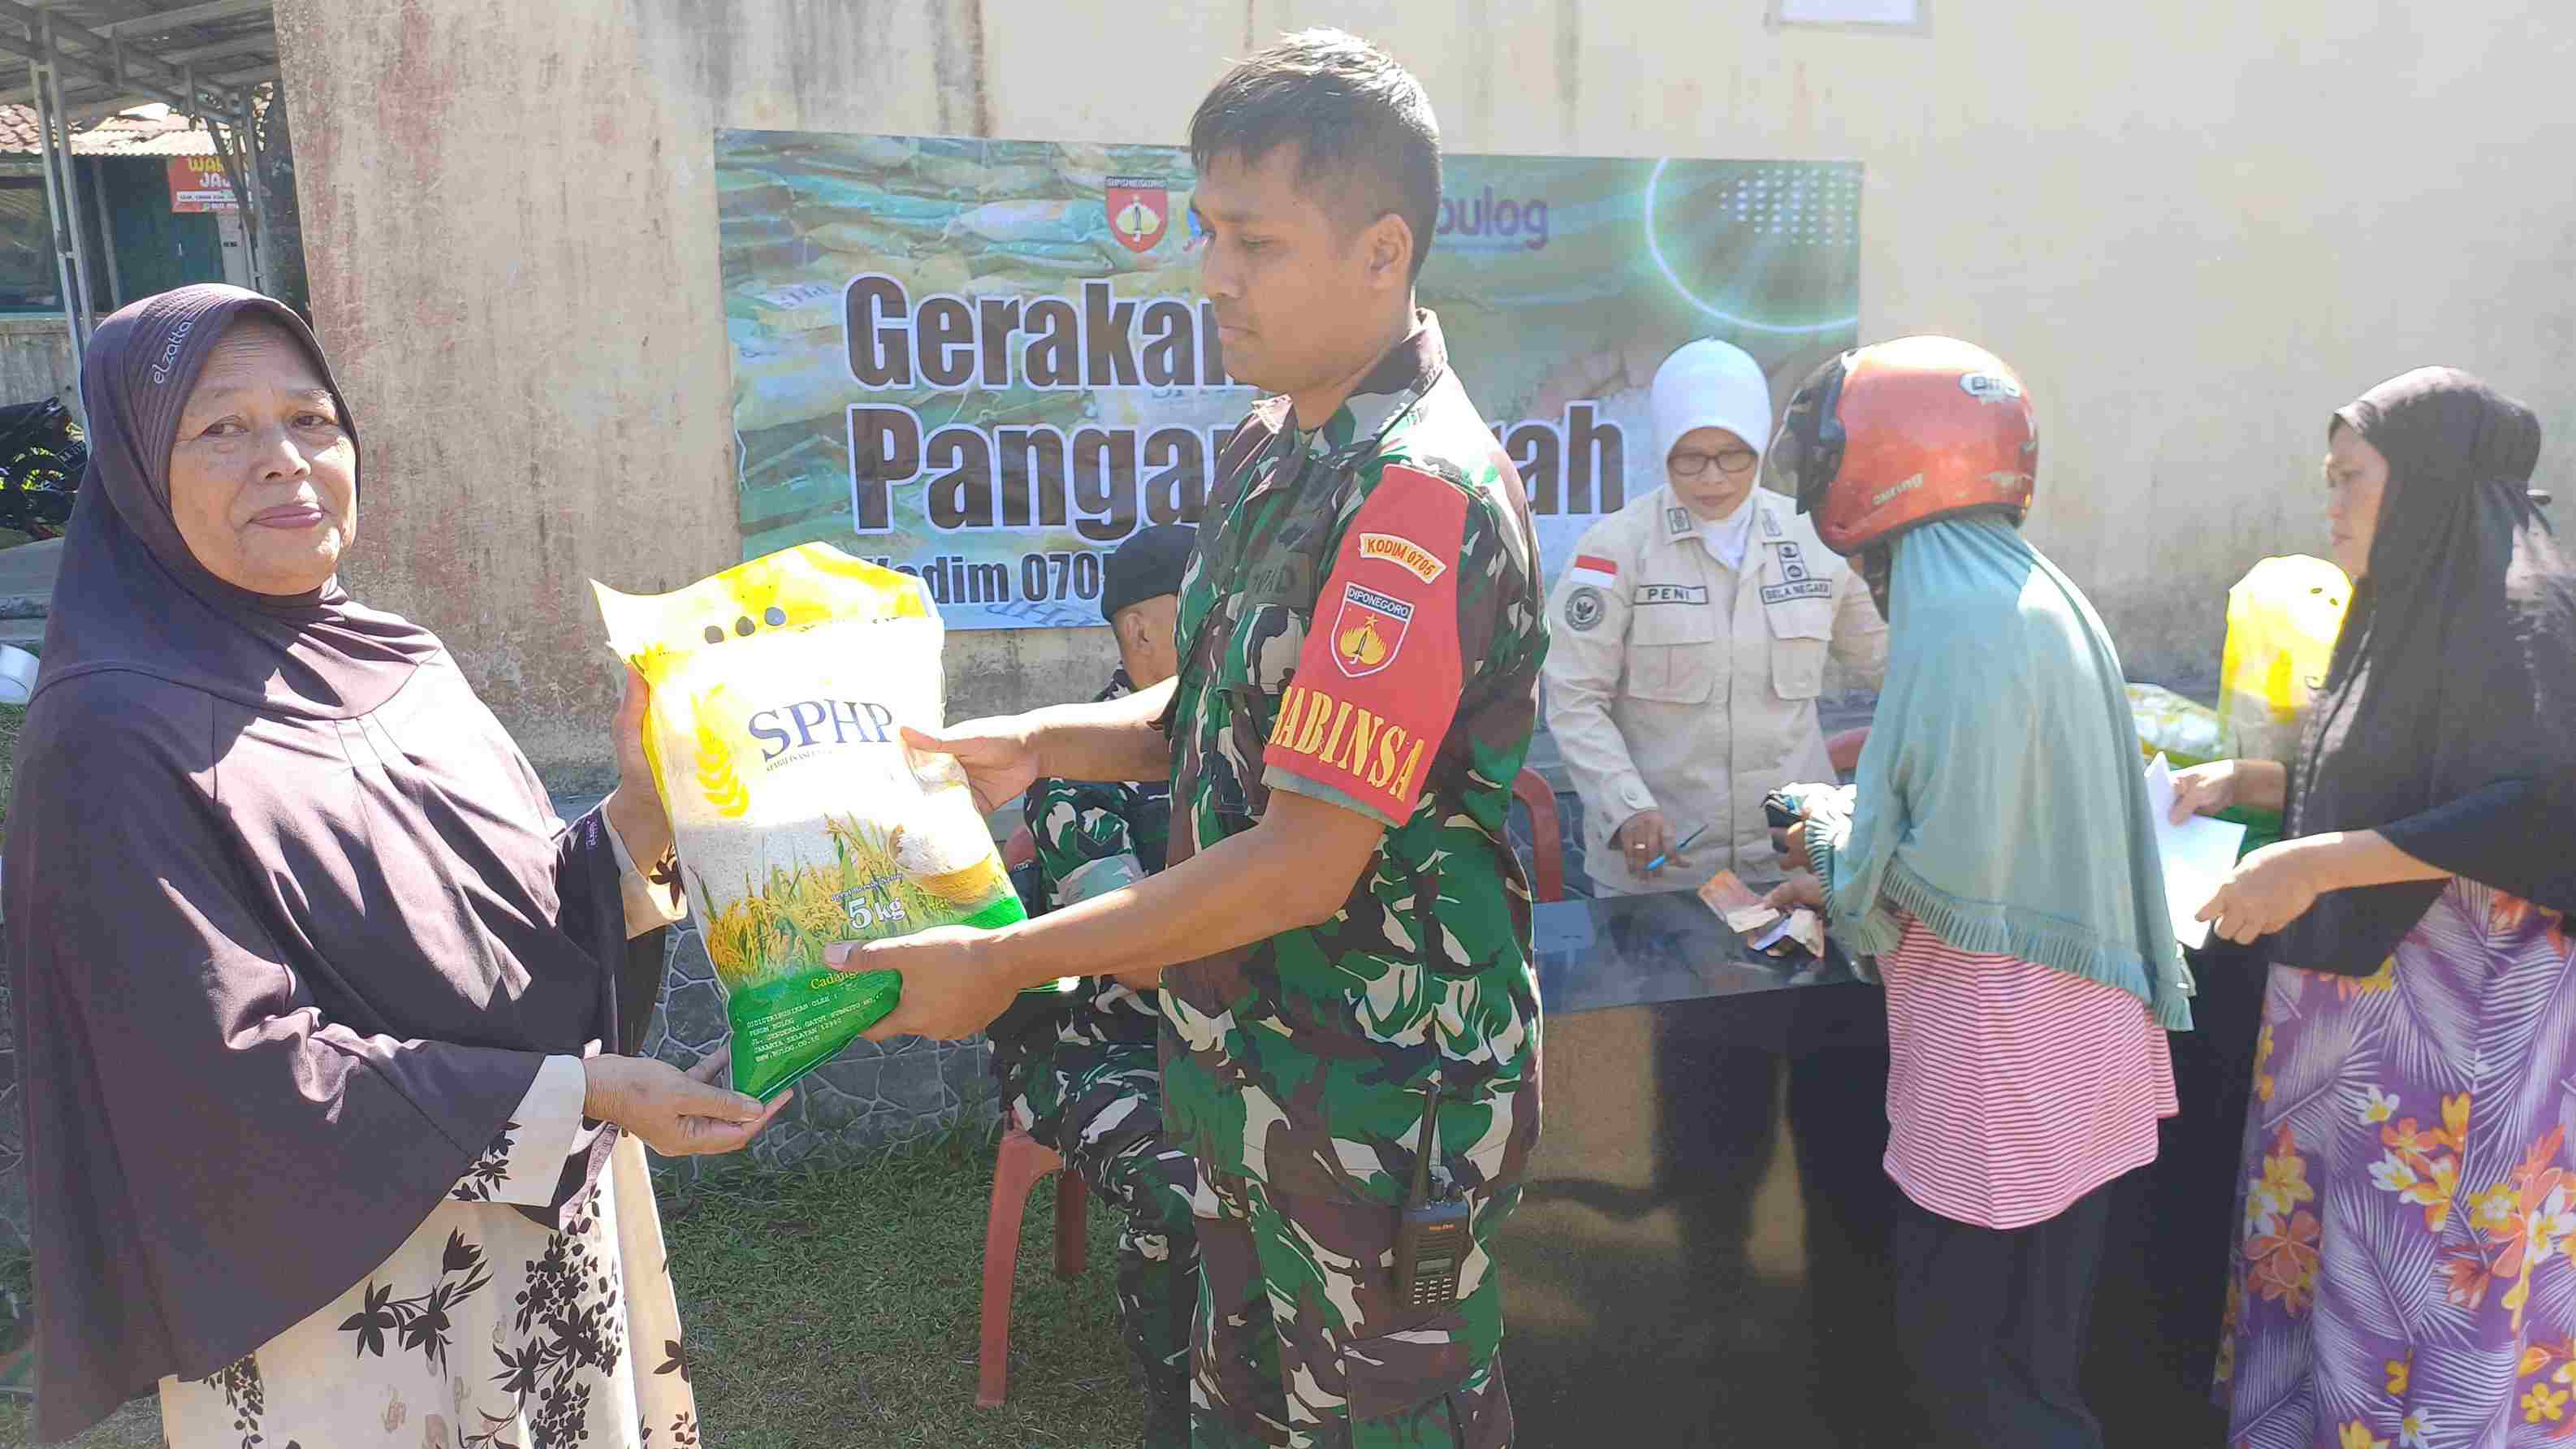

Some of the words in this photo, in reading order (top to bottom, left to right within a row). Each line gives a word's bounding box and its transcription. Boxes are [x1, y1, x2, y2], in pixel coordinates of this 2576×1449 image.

[152, 320, 193, 384] elzatta
[848, 404, 1236, 543] Panga
[1490, 402, 1625, 515] ah
[862, 555, 1009, 604] dim
[1022, 553, 1106, 602] 070
[1366, 538, 1407, 560] KODIM
[1407, 551, 1436, 577] 0705
[1348, 586, 1410, 617] DIPONEGORO
[1648, 588, 1690, 600] PENI
[749, 698, 893, 763] SPHP
[849, 896, 873, 930] 5
[874, 896, 906, 923] kg
